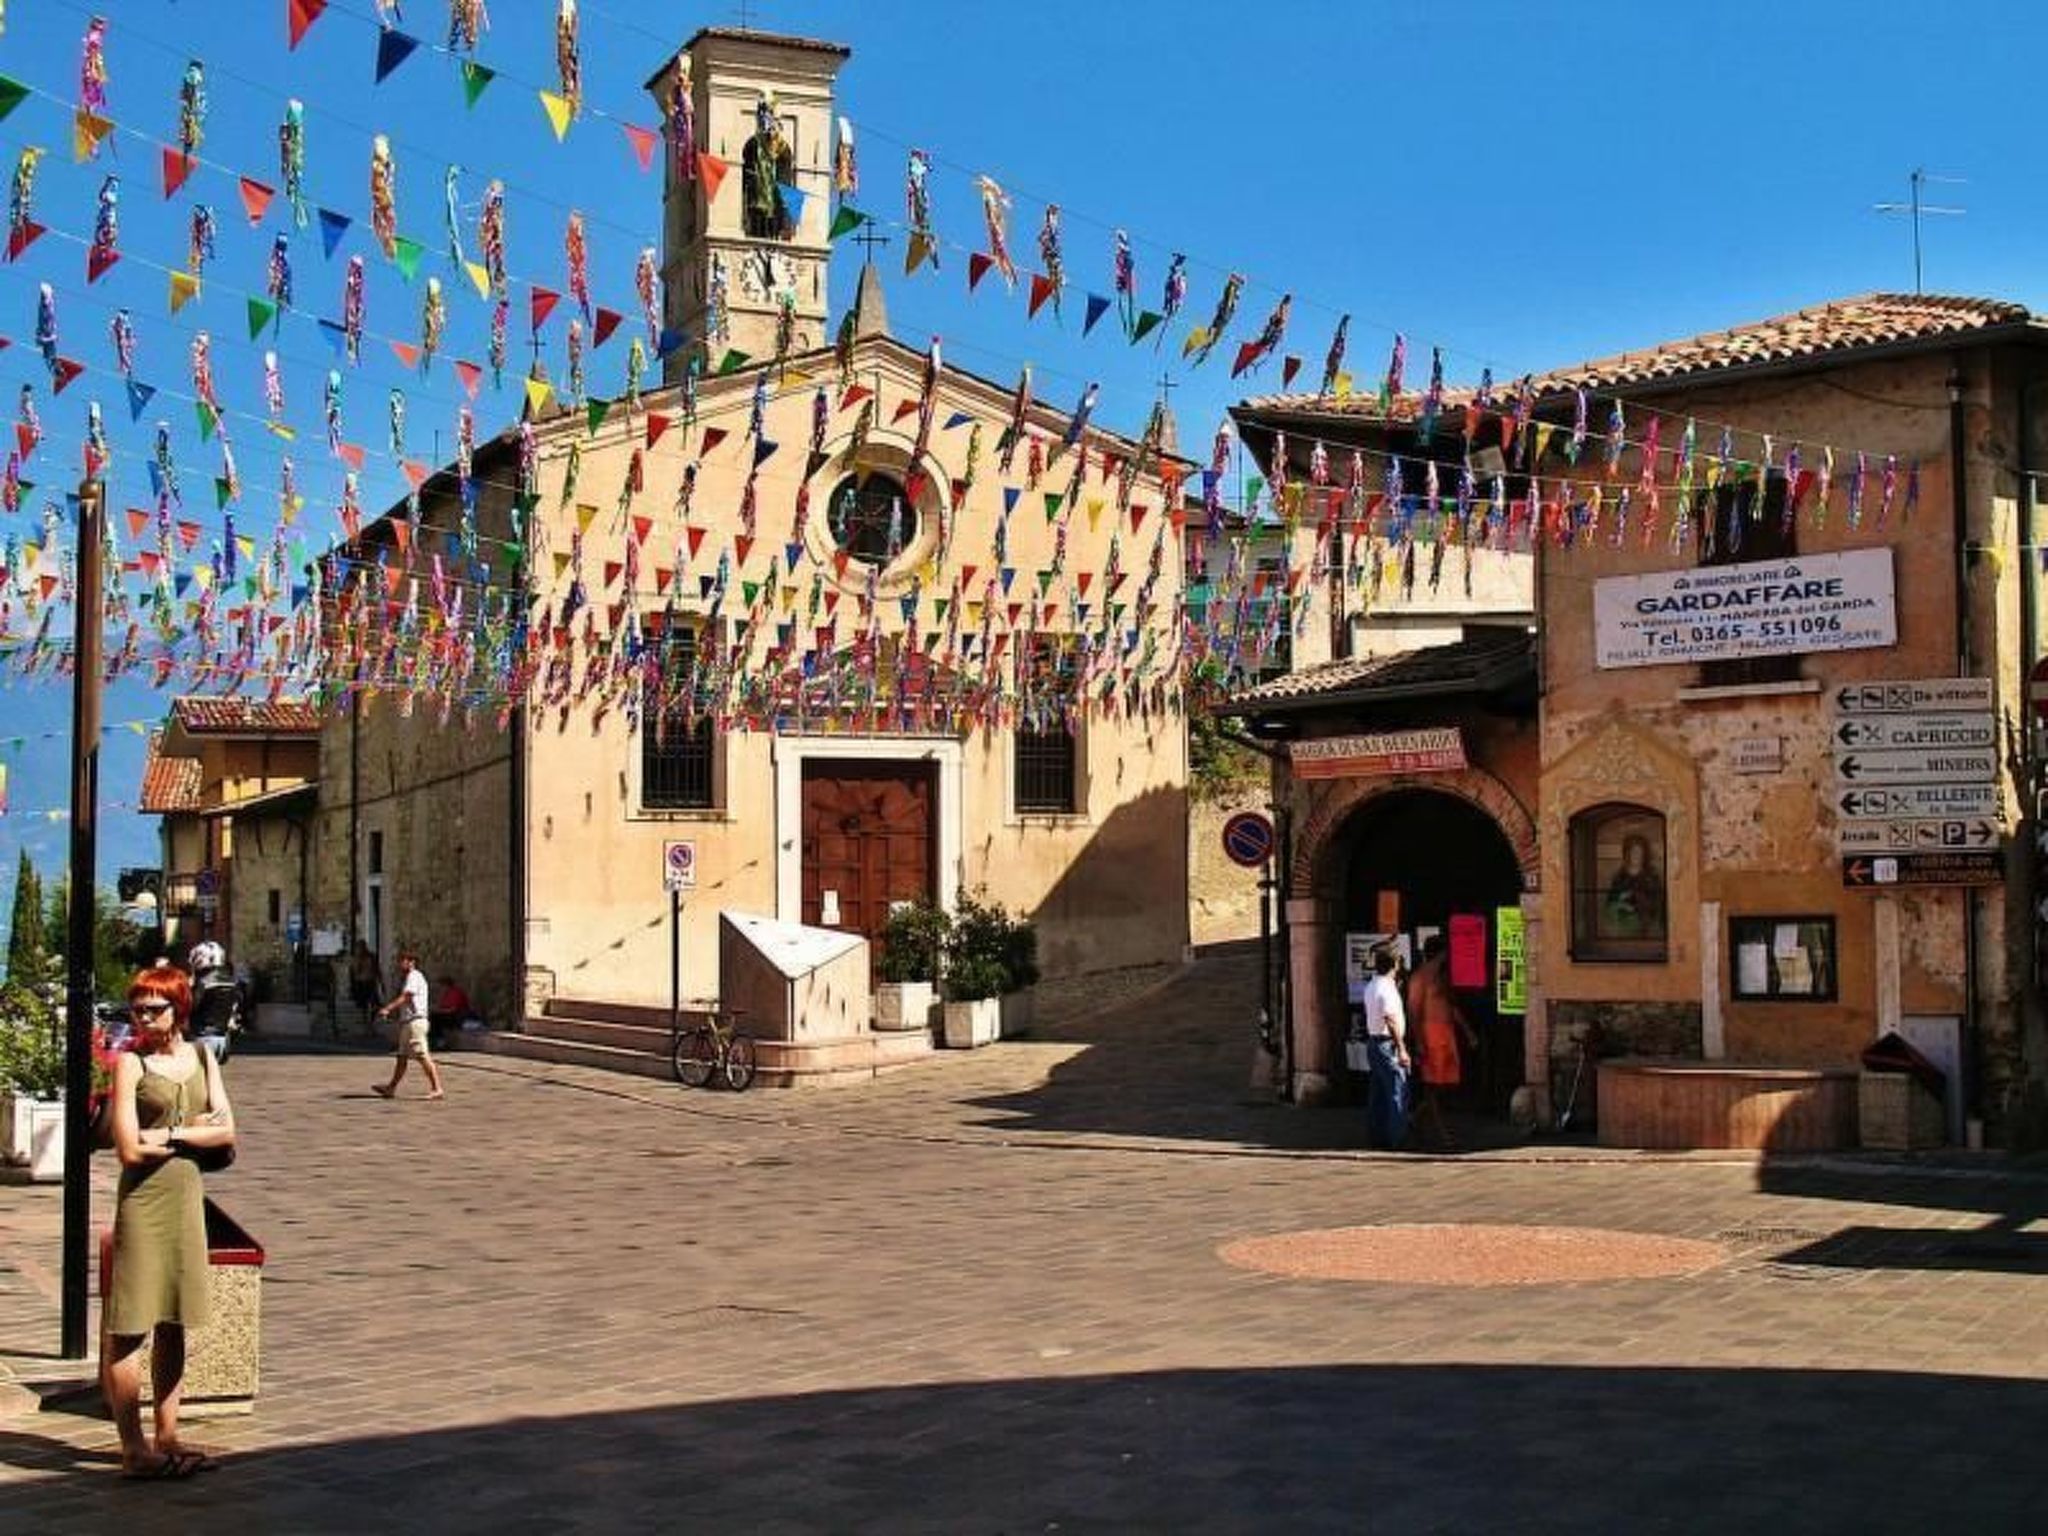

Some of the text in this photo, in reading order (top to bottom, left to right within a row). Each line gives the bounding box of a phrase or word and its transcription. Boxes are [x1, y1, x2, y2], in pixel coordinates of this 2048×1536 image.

[1637, 578, 1844, 613] GARDAFFARE
[1820, 598, 1875, 612] GARDA
[1643, 629, 1685, 647] Tel.
[1891, 729, 1990, 744] CAPRICCIO
